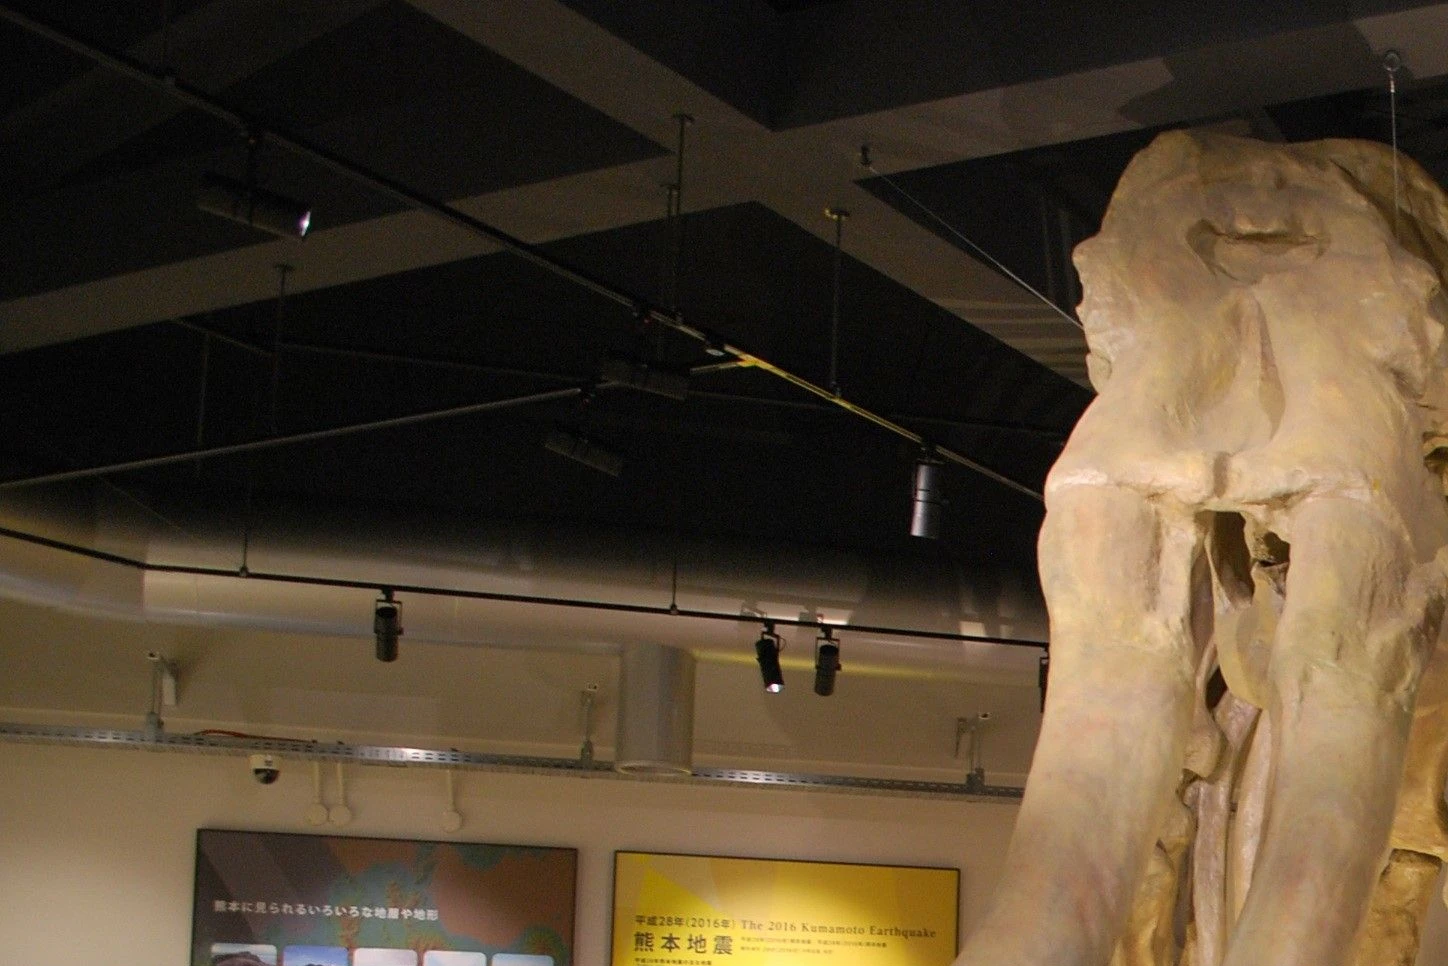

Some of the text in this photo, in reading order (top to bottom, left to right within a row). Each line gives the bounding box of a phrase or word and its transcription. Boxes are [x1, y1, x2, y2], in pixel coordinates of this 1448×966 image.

[214, 900, 439, 921] 熊本に見られるいろいろな地層や地形
[742, 920, 936, 939] The 2016 Kumamoto Earthquake
[634, 931, 733, 955] 熊本地震
